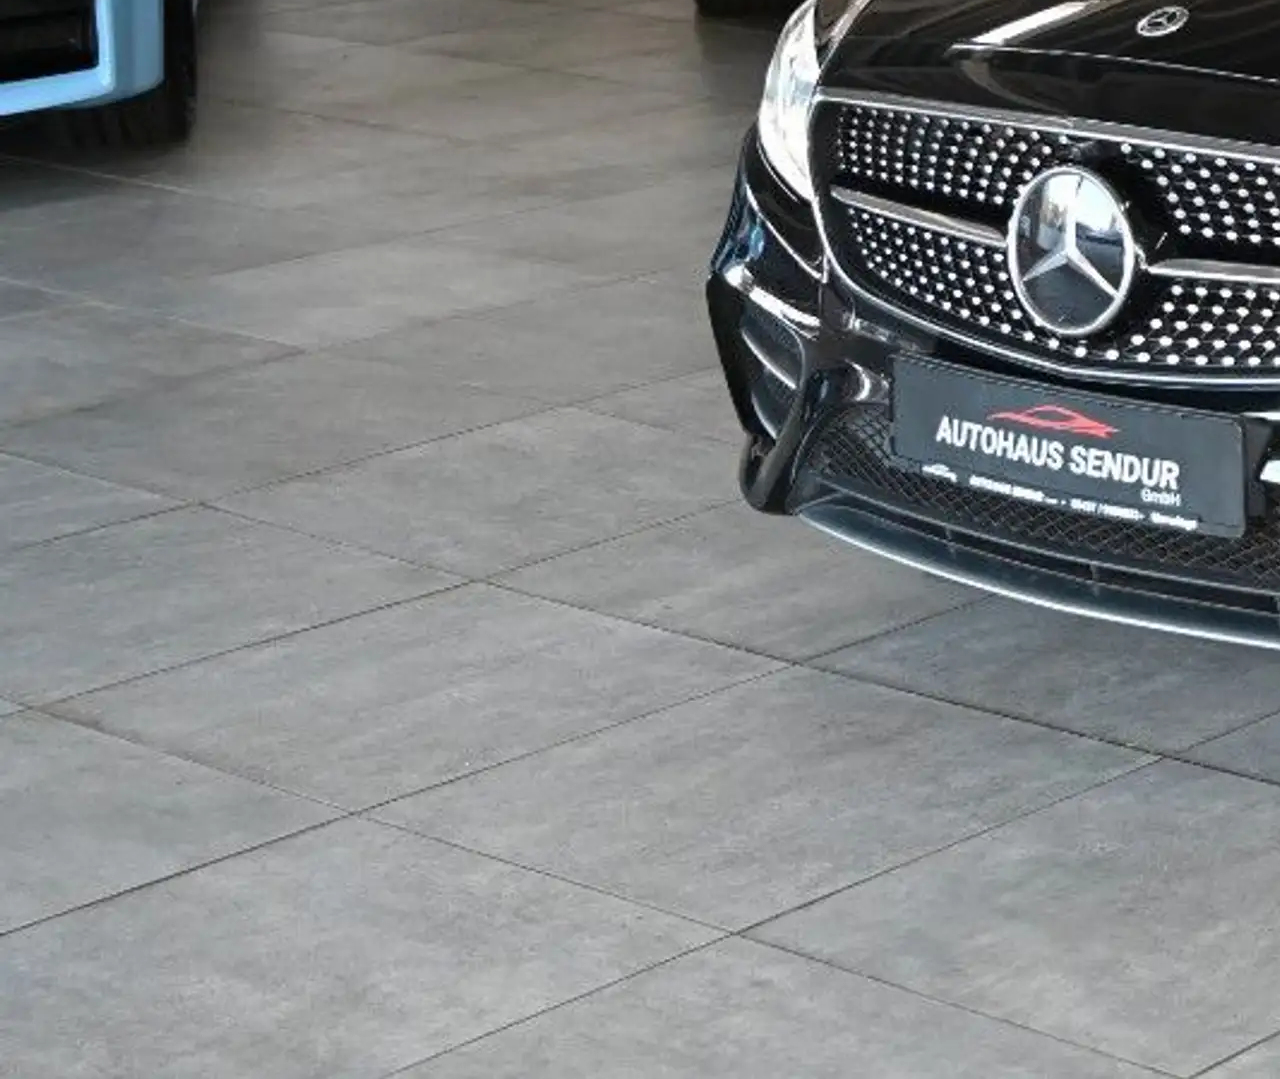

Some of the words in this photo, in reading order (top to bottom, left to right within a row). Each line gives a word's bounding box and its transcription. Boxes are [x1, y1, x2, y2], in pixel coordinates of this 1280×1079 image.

[935, 415, 1065, 471] AUTOHAUS
[1069, 444, 1181, 491] SENDUR
[1140, 487, 1182, 508] GmbH
